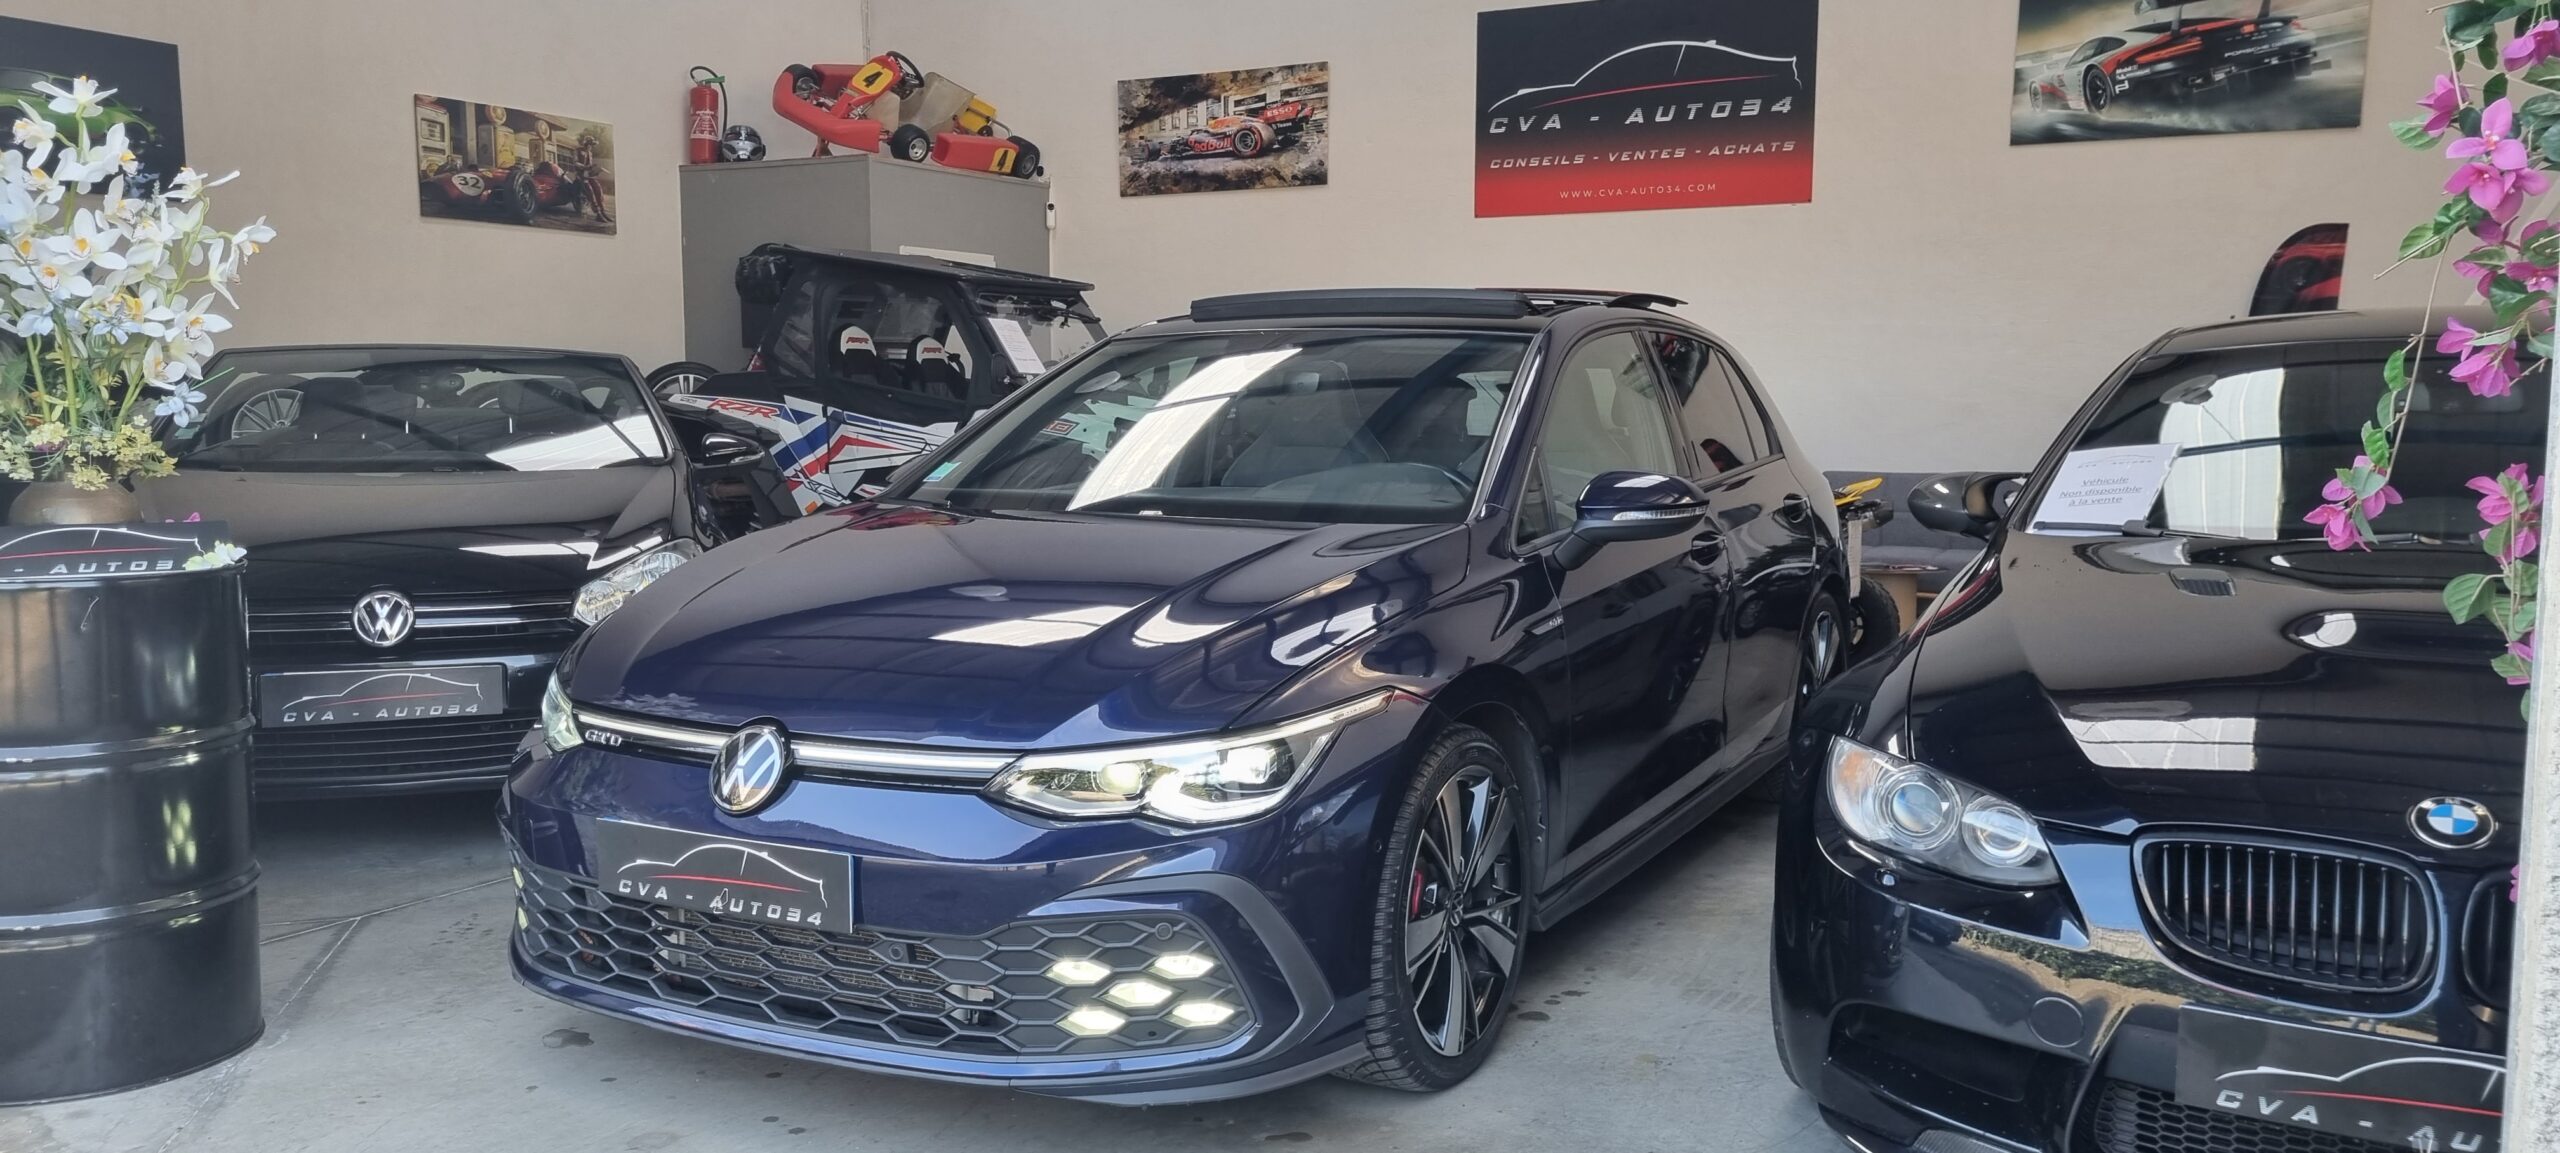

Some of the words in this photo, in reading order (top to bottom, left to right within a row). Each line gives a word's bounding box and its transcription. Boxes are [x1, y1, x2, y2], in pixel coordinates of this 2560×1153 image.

[862, 71, 884, 88] 4
[1489, 113, 1563, 134] CVA
[1624, 96, 1794, 124] AUTO34
[997, 149, 1009, 171] 4
[1490, 154, 1586, 169] CONSEILS
[1608, 147, 1686, 162] VENTES
[1708, 140, 1797, 156] ACHATS
[457, 175, 481, 189] 32
[1559, 183, 1717, 199] WWW.CVA-AUTO34.COM
[706, 399, 780, 419] RZR
[2084, 486, 2142, 496] disponible
[2091, 496, 2123, 504] vente
[283, 711, 335, 723] CVA
[376, 703, 480, 718] AUTO34
[585, 729, 623, 747] GTD
[618, 879, 669, 900] CVA
[709, 896, 823, 926] AUTO34
[2215, 1089, 2320, 1125] CVA
[2406, 1124, 2504, 1153] AU
